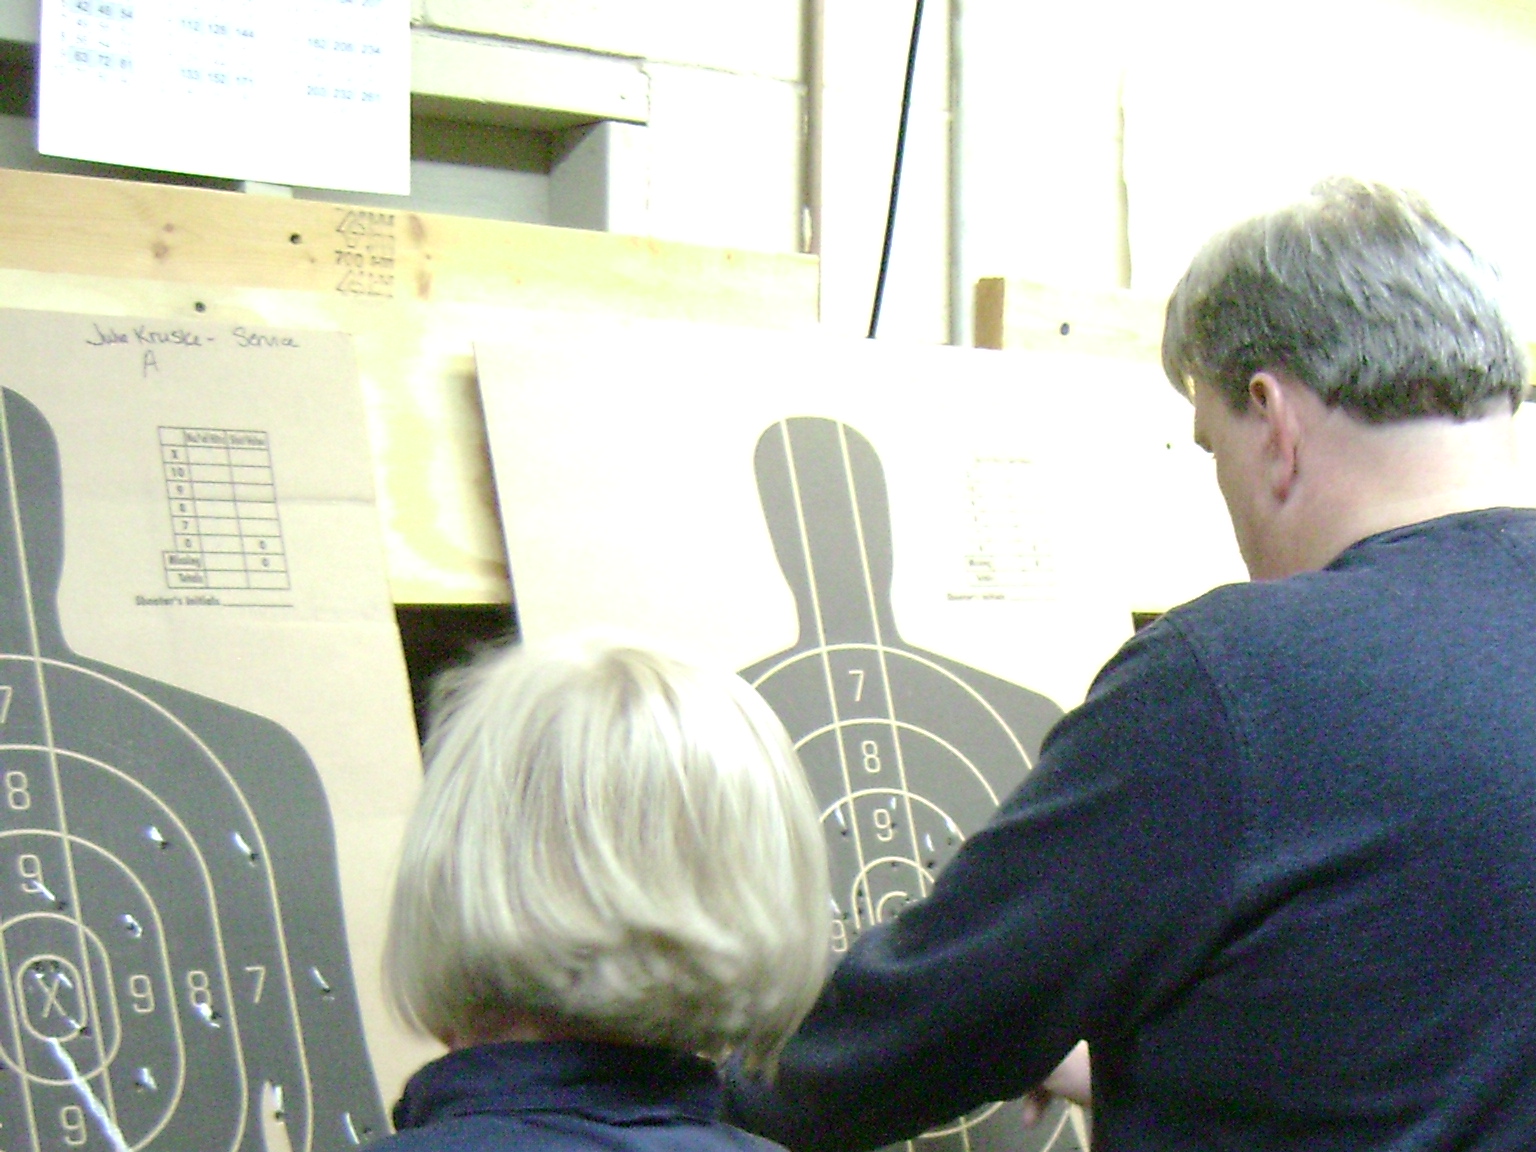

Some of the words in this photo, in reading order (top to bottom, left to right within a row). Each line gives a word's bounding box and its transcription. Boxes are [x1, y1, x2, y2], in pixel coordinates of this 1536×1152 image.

[141, 348, 160, 379] A
[170, 466, 185, 478] 10
[175, 484, 184, 495] 9
[181, 520, 189, 530] 7
[848, 669, 865, 702] 7
[861, 740, 881, 773] 8
[5, 771, 31, 811] 8
[873, 808, 894, 842] 9
[19, 854, 44, 893] 9
[128, 974, 156, 1013] 9
[186, 970, 212, 1008] 8
[244, 965, 267, 1004] 7
[59, 1105, 88, 1146] 9
